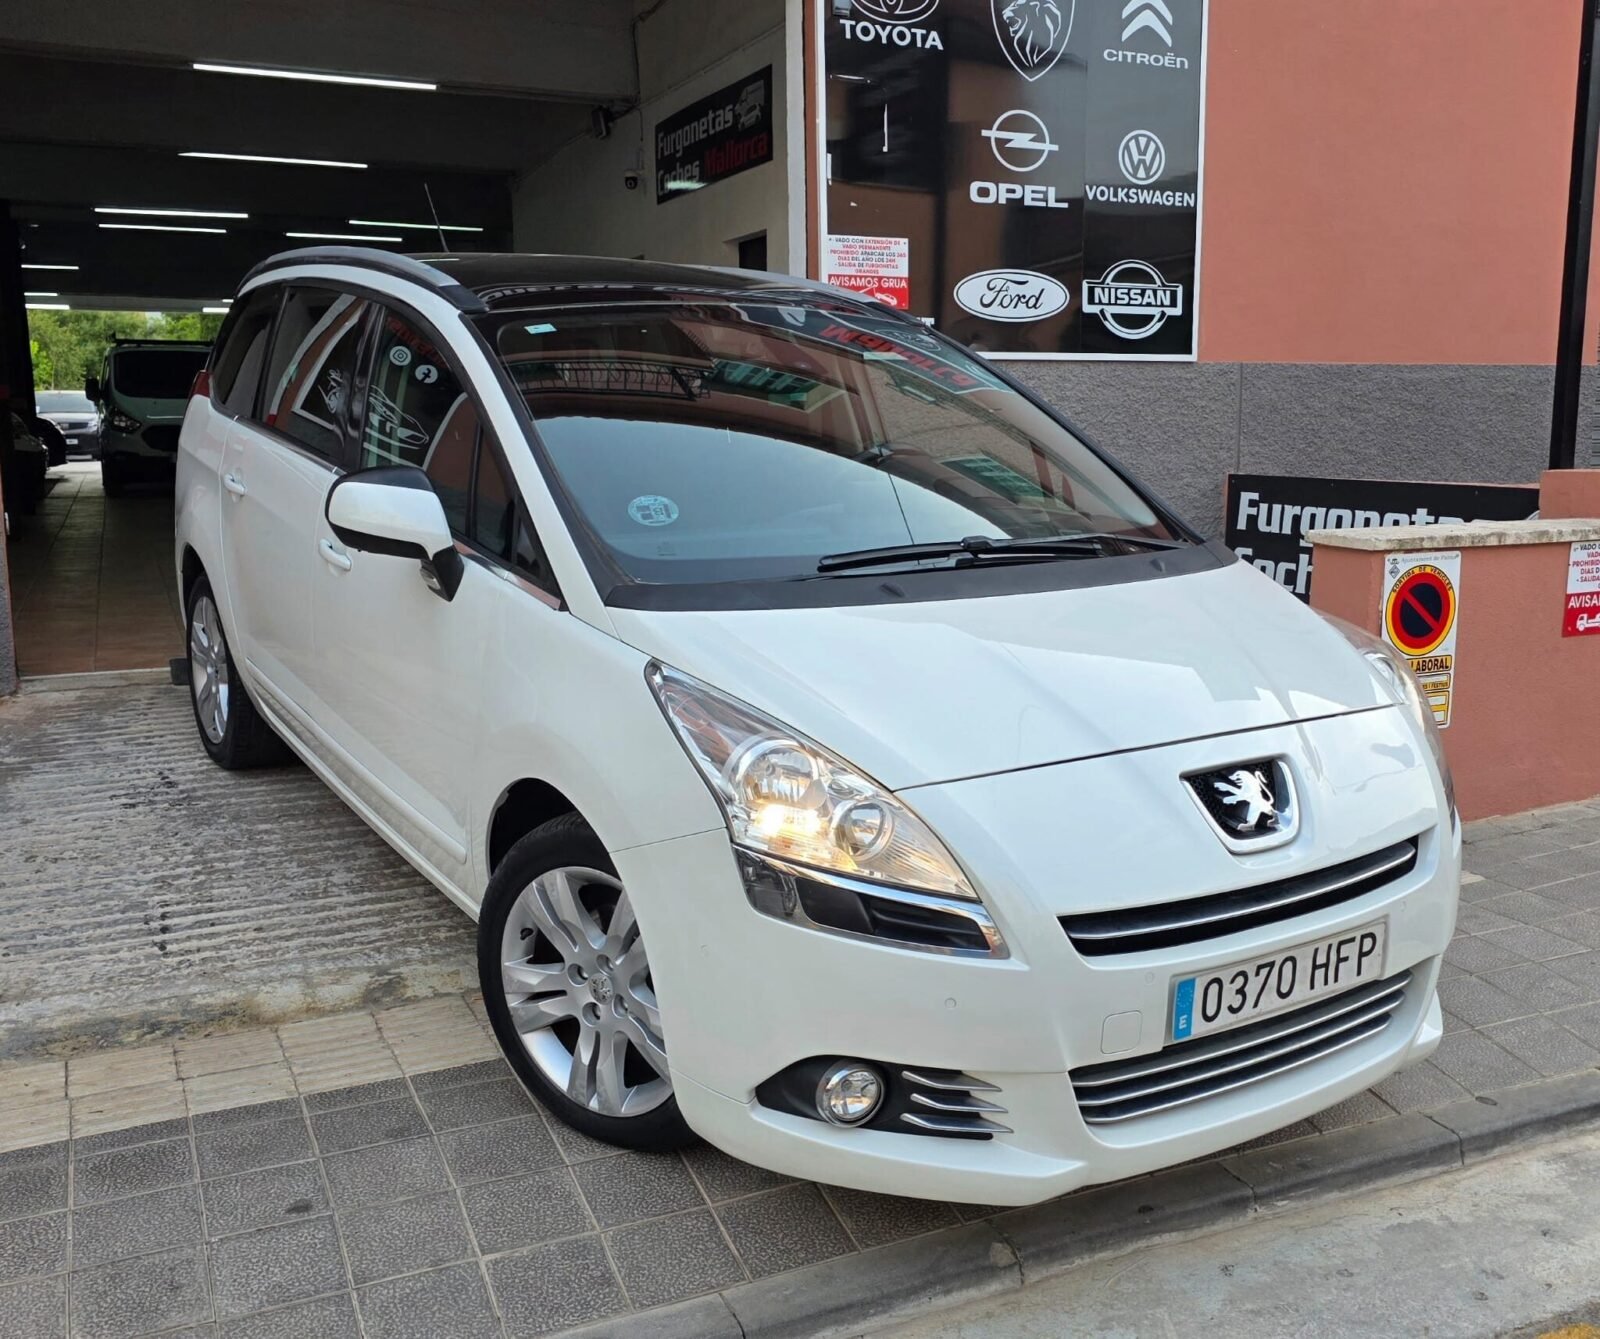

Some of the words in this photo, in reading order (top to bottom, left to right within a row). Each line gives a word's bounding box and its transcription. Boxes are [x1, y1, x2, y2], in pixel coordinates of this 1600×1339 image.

[840, 19, 944, 51] TOYOTA
[658, 104, 734, 160] Furgonetas
[704, 131, 769, 178] Mallorca
[969, 181, 1069, 208] OPEL
[1085, 184, 1195, 207] VOLKSWAGEN
[829, 276, 879, 288] AVISAMOS
[881, 277, 907, 289] GRUA
[980, 277, 1046, 311] Ford
[1094, 288, 1171, 306] NISSAN
[1236, 491, 1499, 548] Furgon
[1580, 543, 1597, 551] VADO
[1568, 593, 1600, 609] AVISA
[1201, 955, 1297, 1023] 0370
[1309, 932, 1377, 991] HFP
[1178, 1014, 1187, 1030] E
